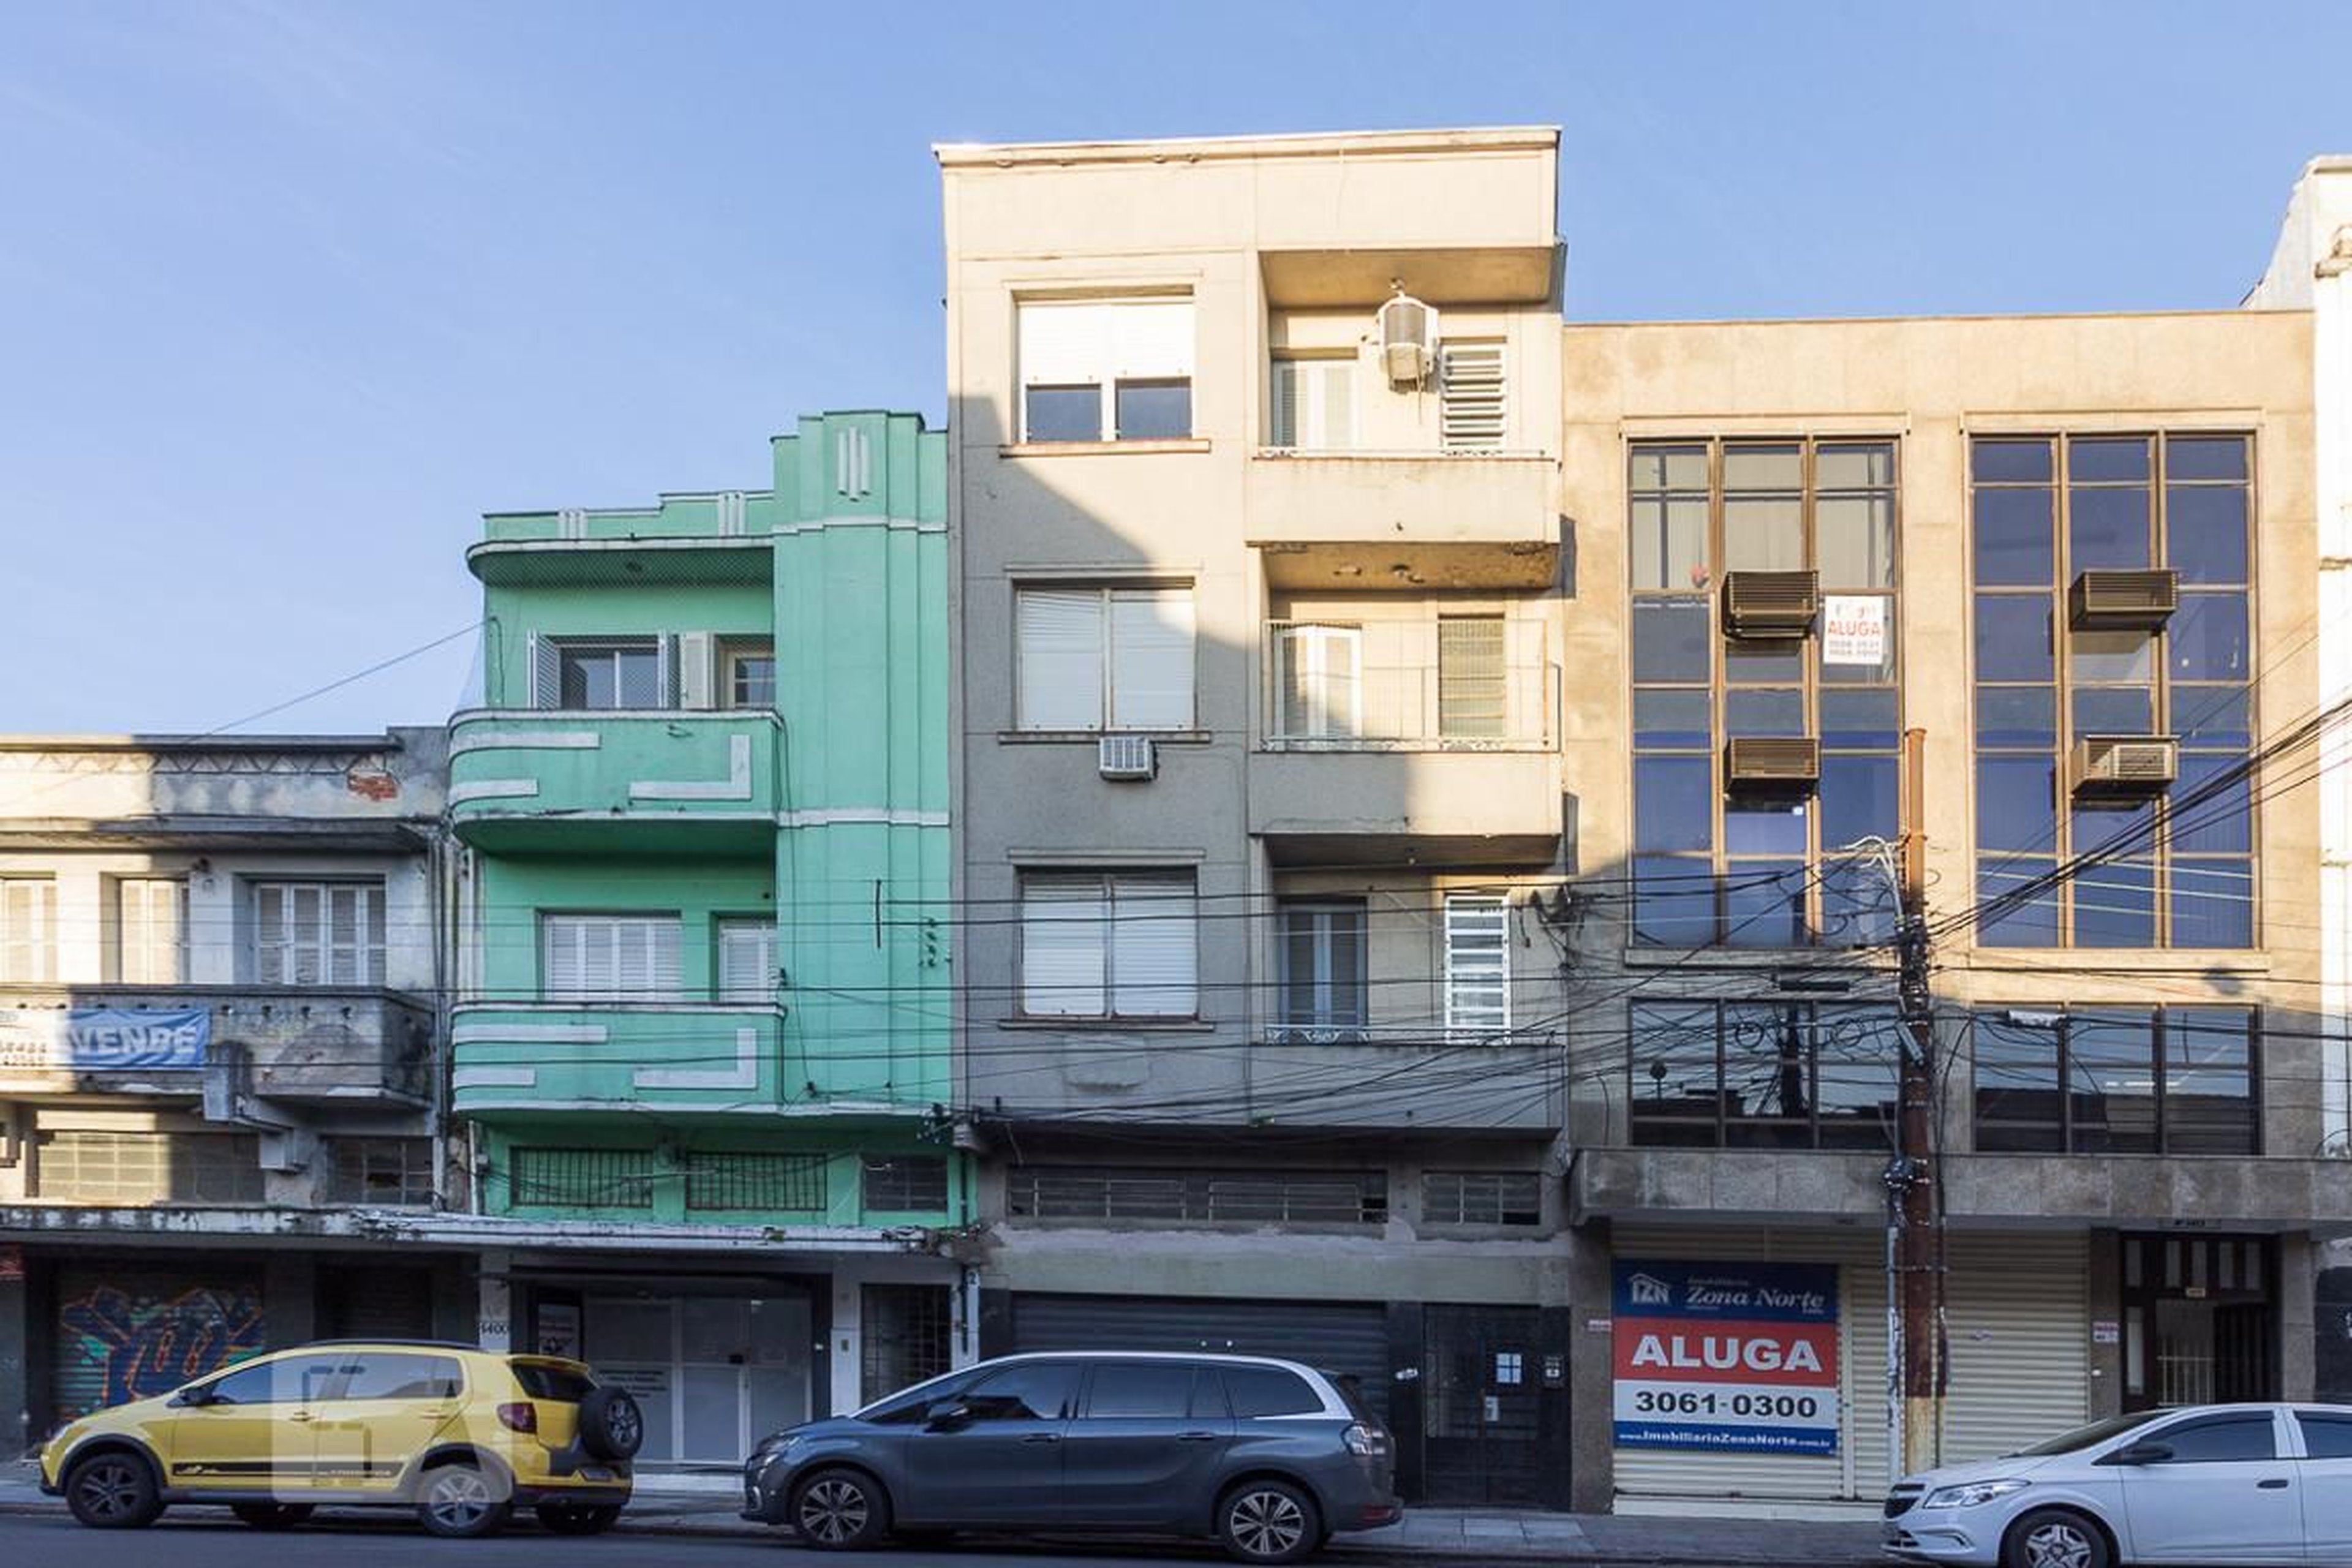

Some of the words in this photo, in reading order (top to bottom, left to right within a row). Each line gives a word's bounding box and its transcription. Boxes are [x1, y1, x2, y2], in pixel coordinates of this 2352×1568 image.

[1828, 620, 1880, 636] ALUGA
[69, 1026, 197, 1054] VENDE
[1685, 1287, 1749, 1306] Zona
[1754, 1289, 1825, 1308] Norte
[1631, 1334, 1823, 1373] ALUGA
[1635, 1391, 1818, 1418] 3061-0300
